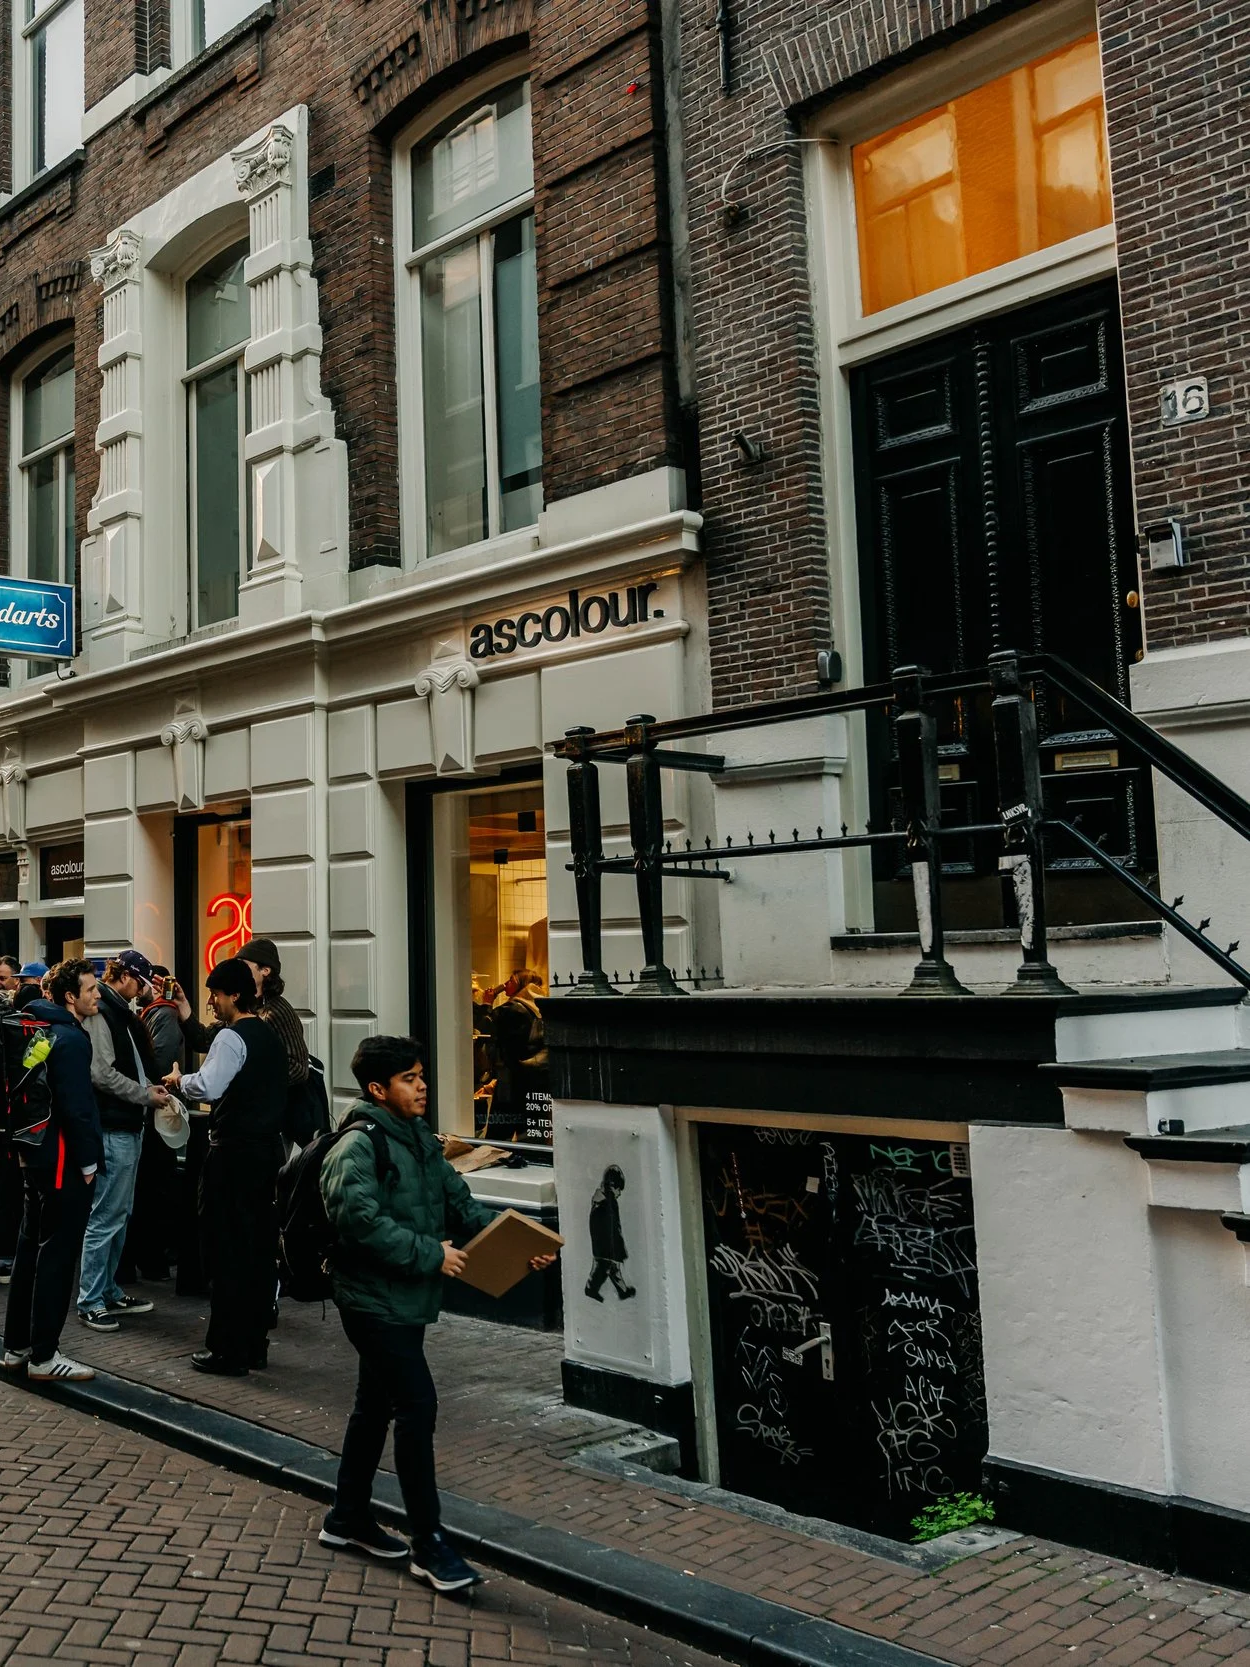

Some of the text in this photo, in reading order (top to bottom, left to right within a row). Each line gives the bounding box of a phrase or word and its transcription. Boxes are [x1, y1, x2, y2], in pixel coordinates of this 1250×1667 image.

[1164, 385, 1204, 419] 16
[470, 582, 665, 659] ascolour.
[525, 1092, 530, 1100] 4
[525, 1103, 553, 1112] 20% OF
[526, 1118, 536, 1126] 5+
[526, 1128, 553, 1139] 25% OF
